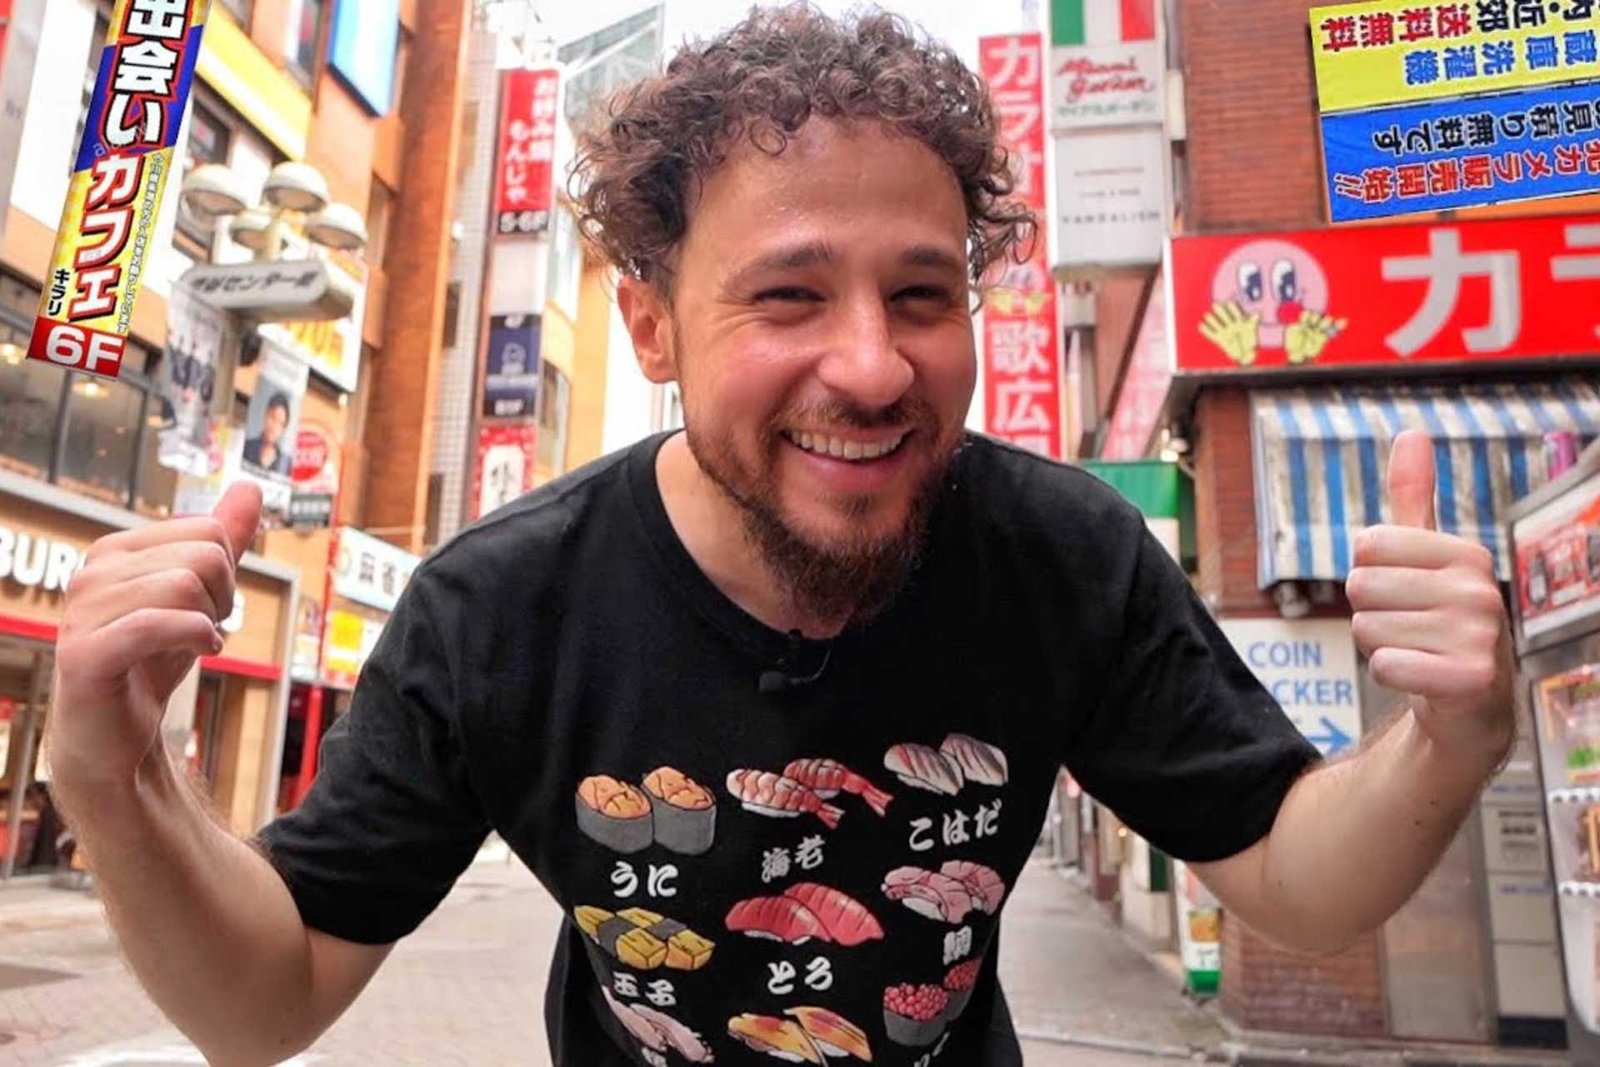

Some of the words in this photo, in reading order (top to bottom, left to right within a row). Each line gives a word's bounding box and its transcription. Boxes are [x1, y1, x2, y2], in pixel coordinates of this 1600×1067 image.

[70, 0, 186, 321] 出会いカフェ
[48, 268, 70, 316] キラリ
[45, 325, 121, 371] 6F
[1249, 641, 1322, 668] COIN
[1263, 679, 1353, 706] CKER
[909, 798, 1002, 851] こはだ
[610, 860, 679, 897] うに
[761, 834, 826, 883] 海老
[768, 956, 833, 995] とろ
